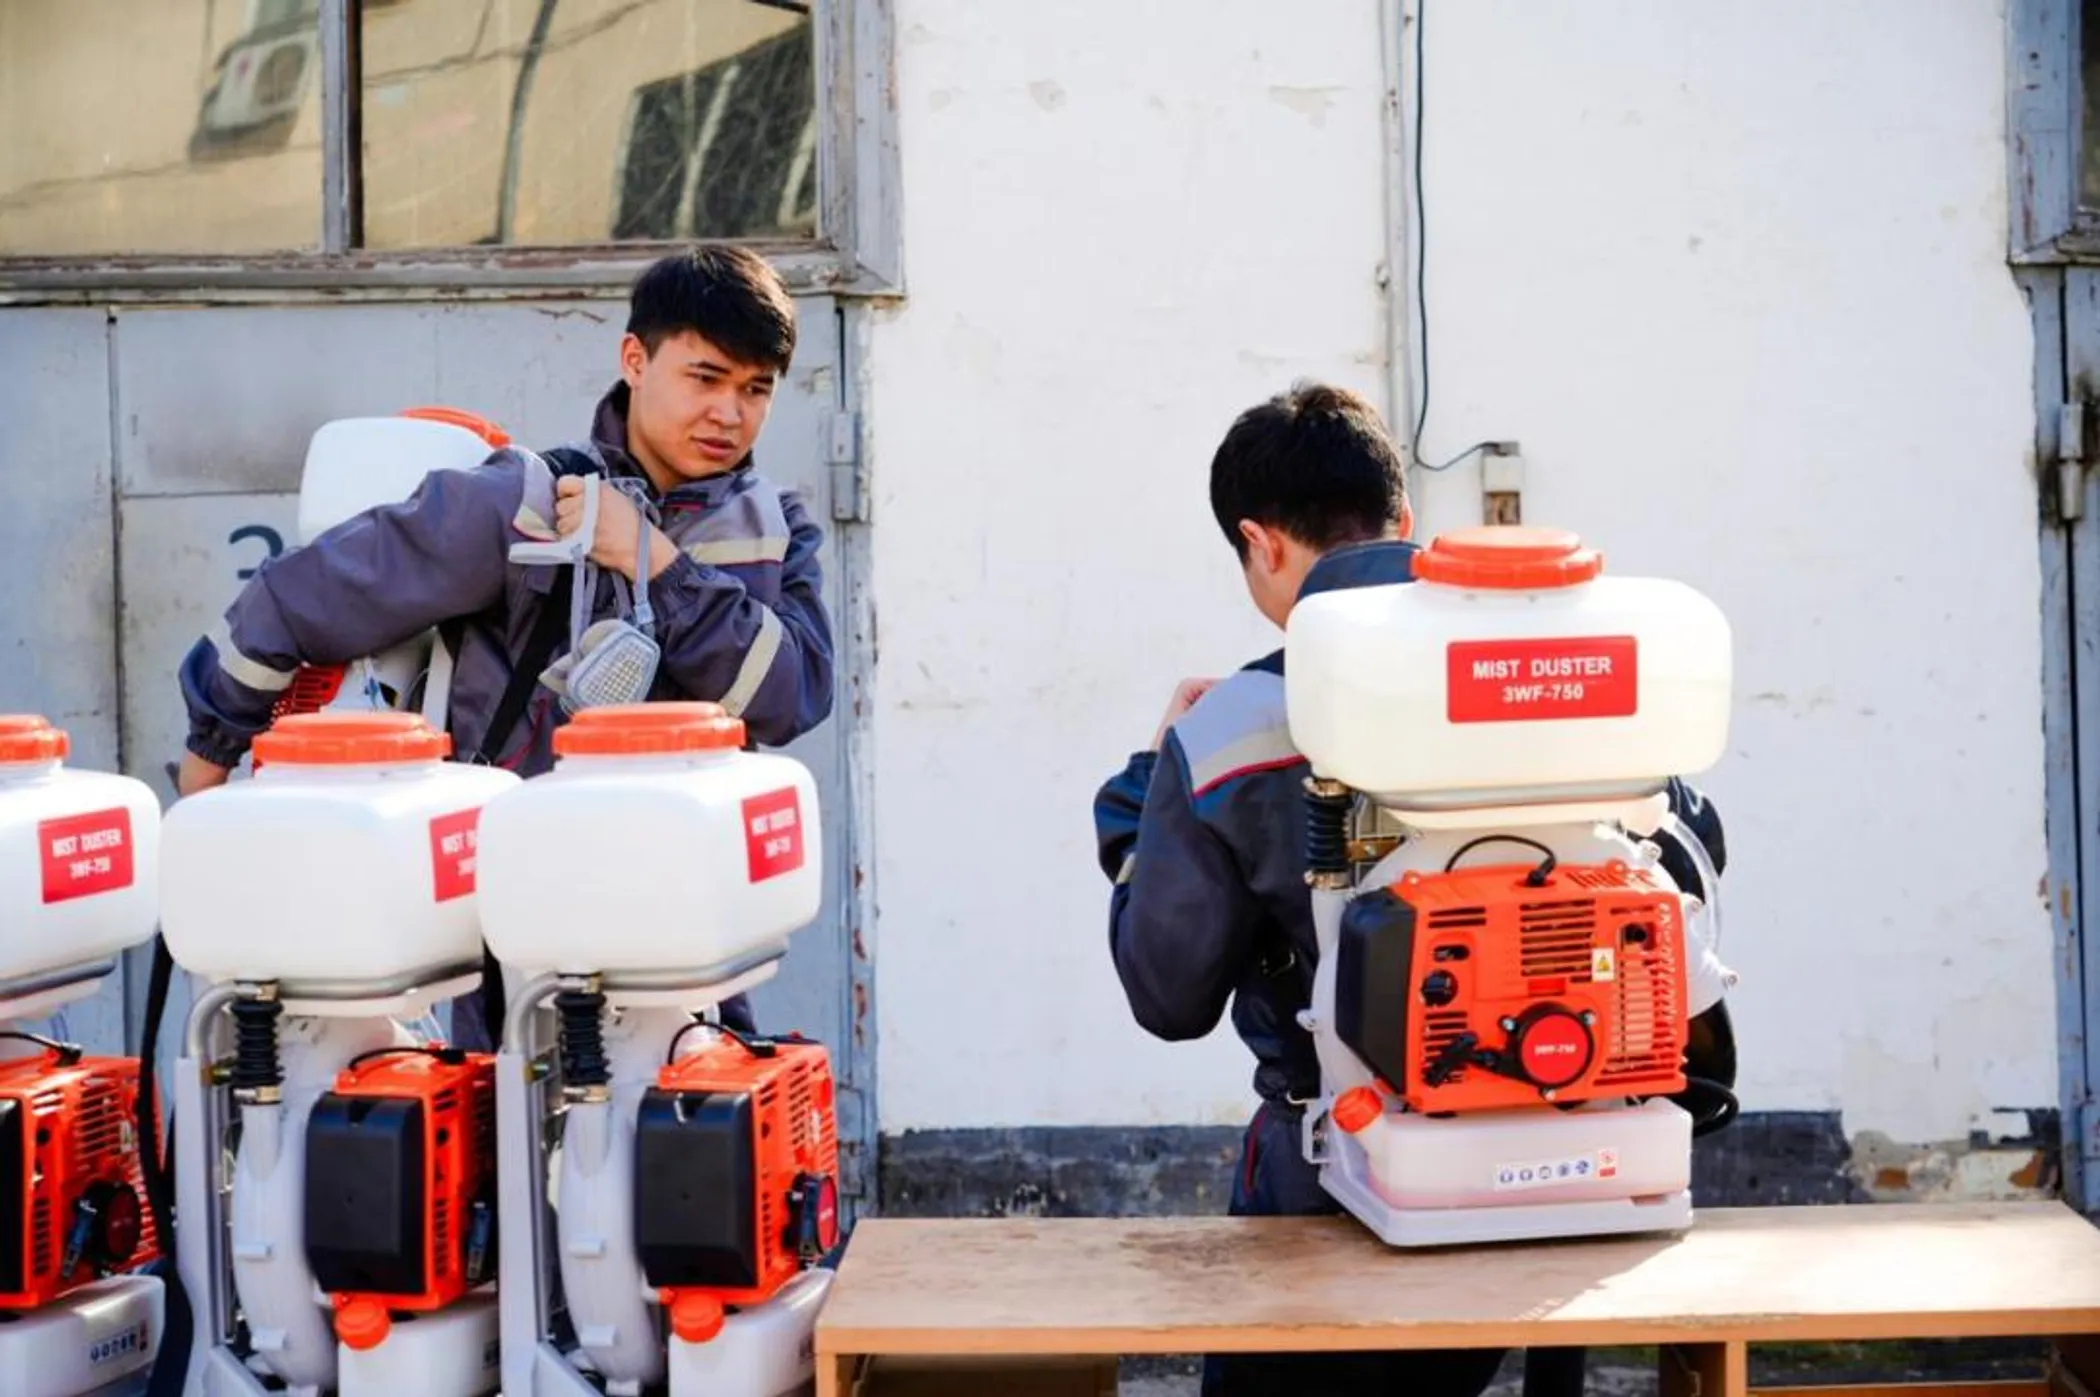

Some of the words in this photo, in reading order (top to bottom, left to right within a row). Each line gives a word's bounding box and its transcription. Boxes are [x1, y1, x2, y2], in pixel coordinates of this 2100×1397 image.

[1472, 659, 1522, 681] MIST
[1530, 656, 1613, 678] DUSTER
[1502, 682, 1585, 704] 3WF-750
